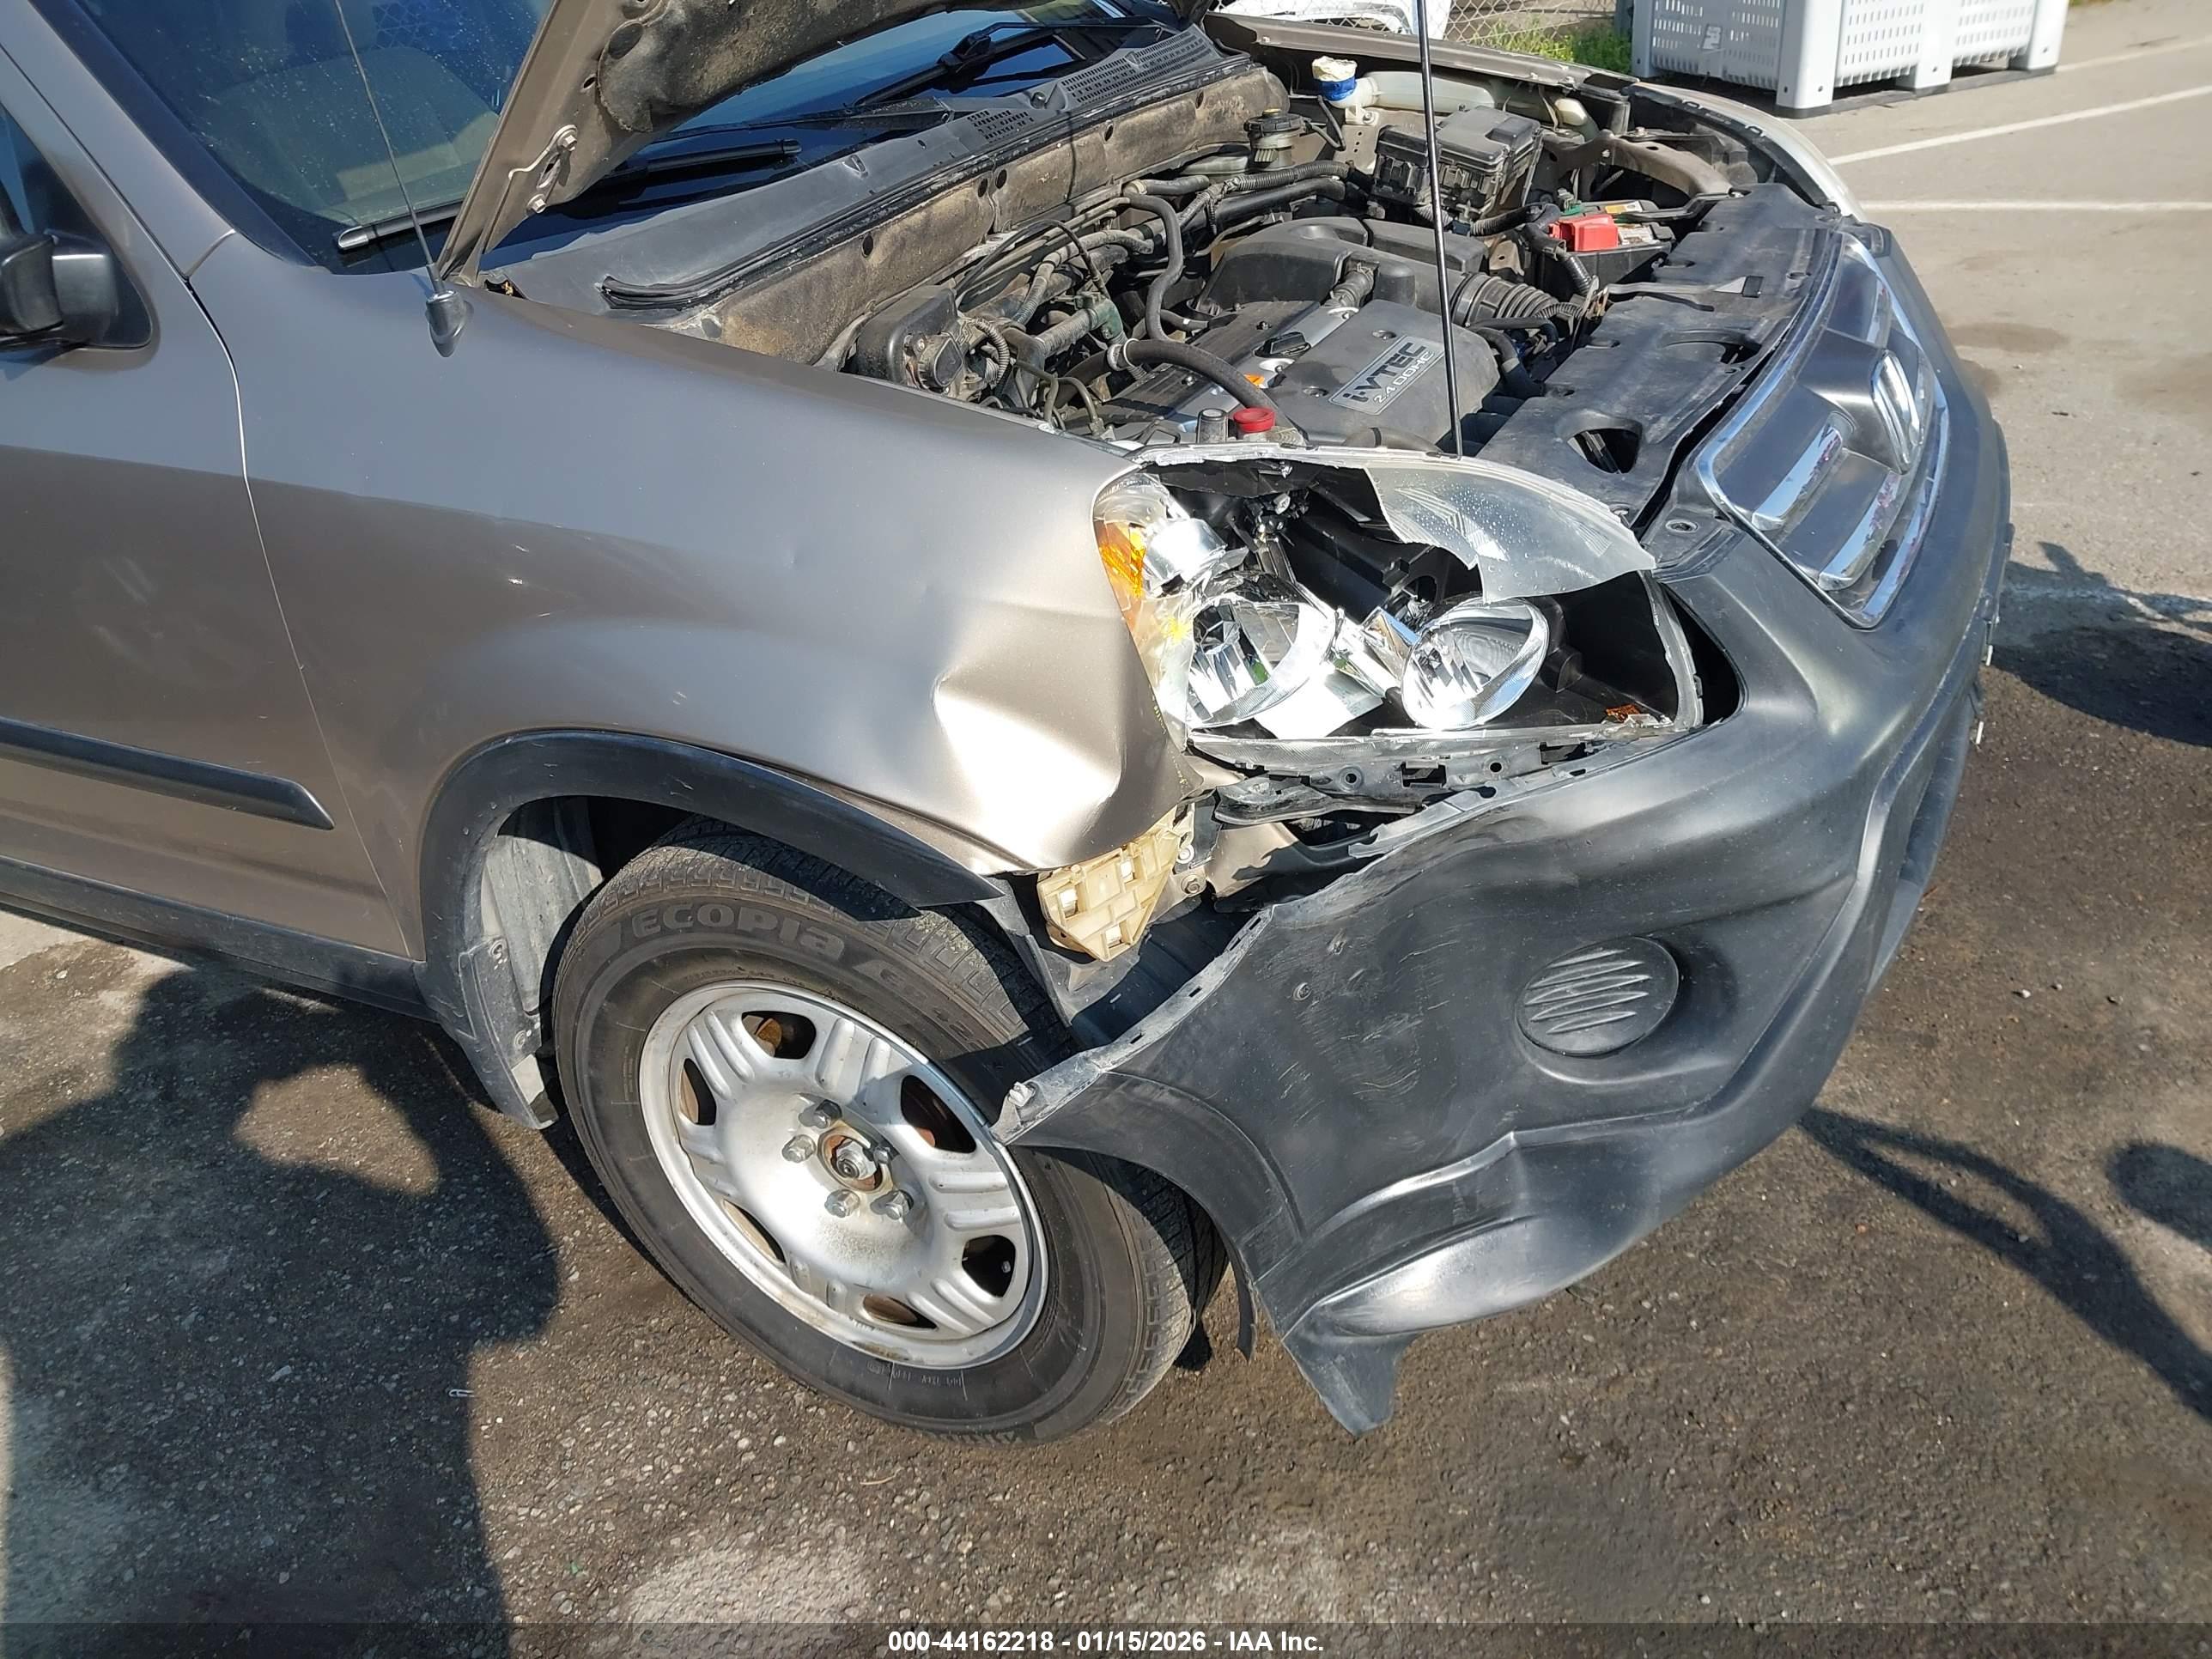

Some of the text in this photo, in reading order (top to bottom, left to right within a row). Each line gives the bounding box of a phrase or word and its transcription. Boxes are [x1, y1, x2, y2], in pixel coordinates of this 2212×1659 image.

[1341, 342, 1427, 403] i-VTEC
[1373, 350, 1436, 404] 2.4 DOHC
